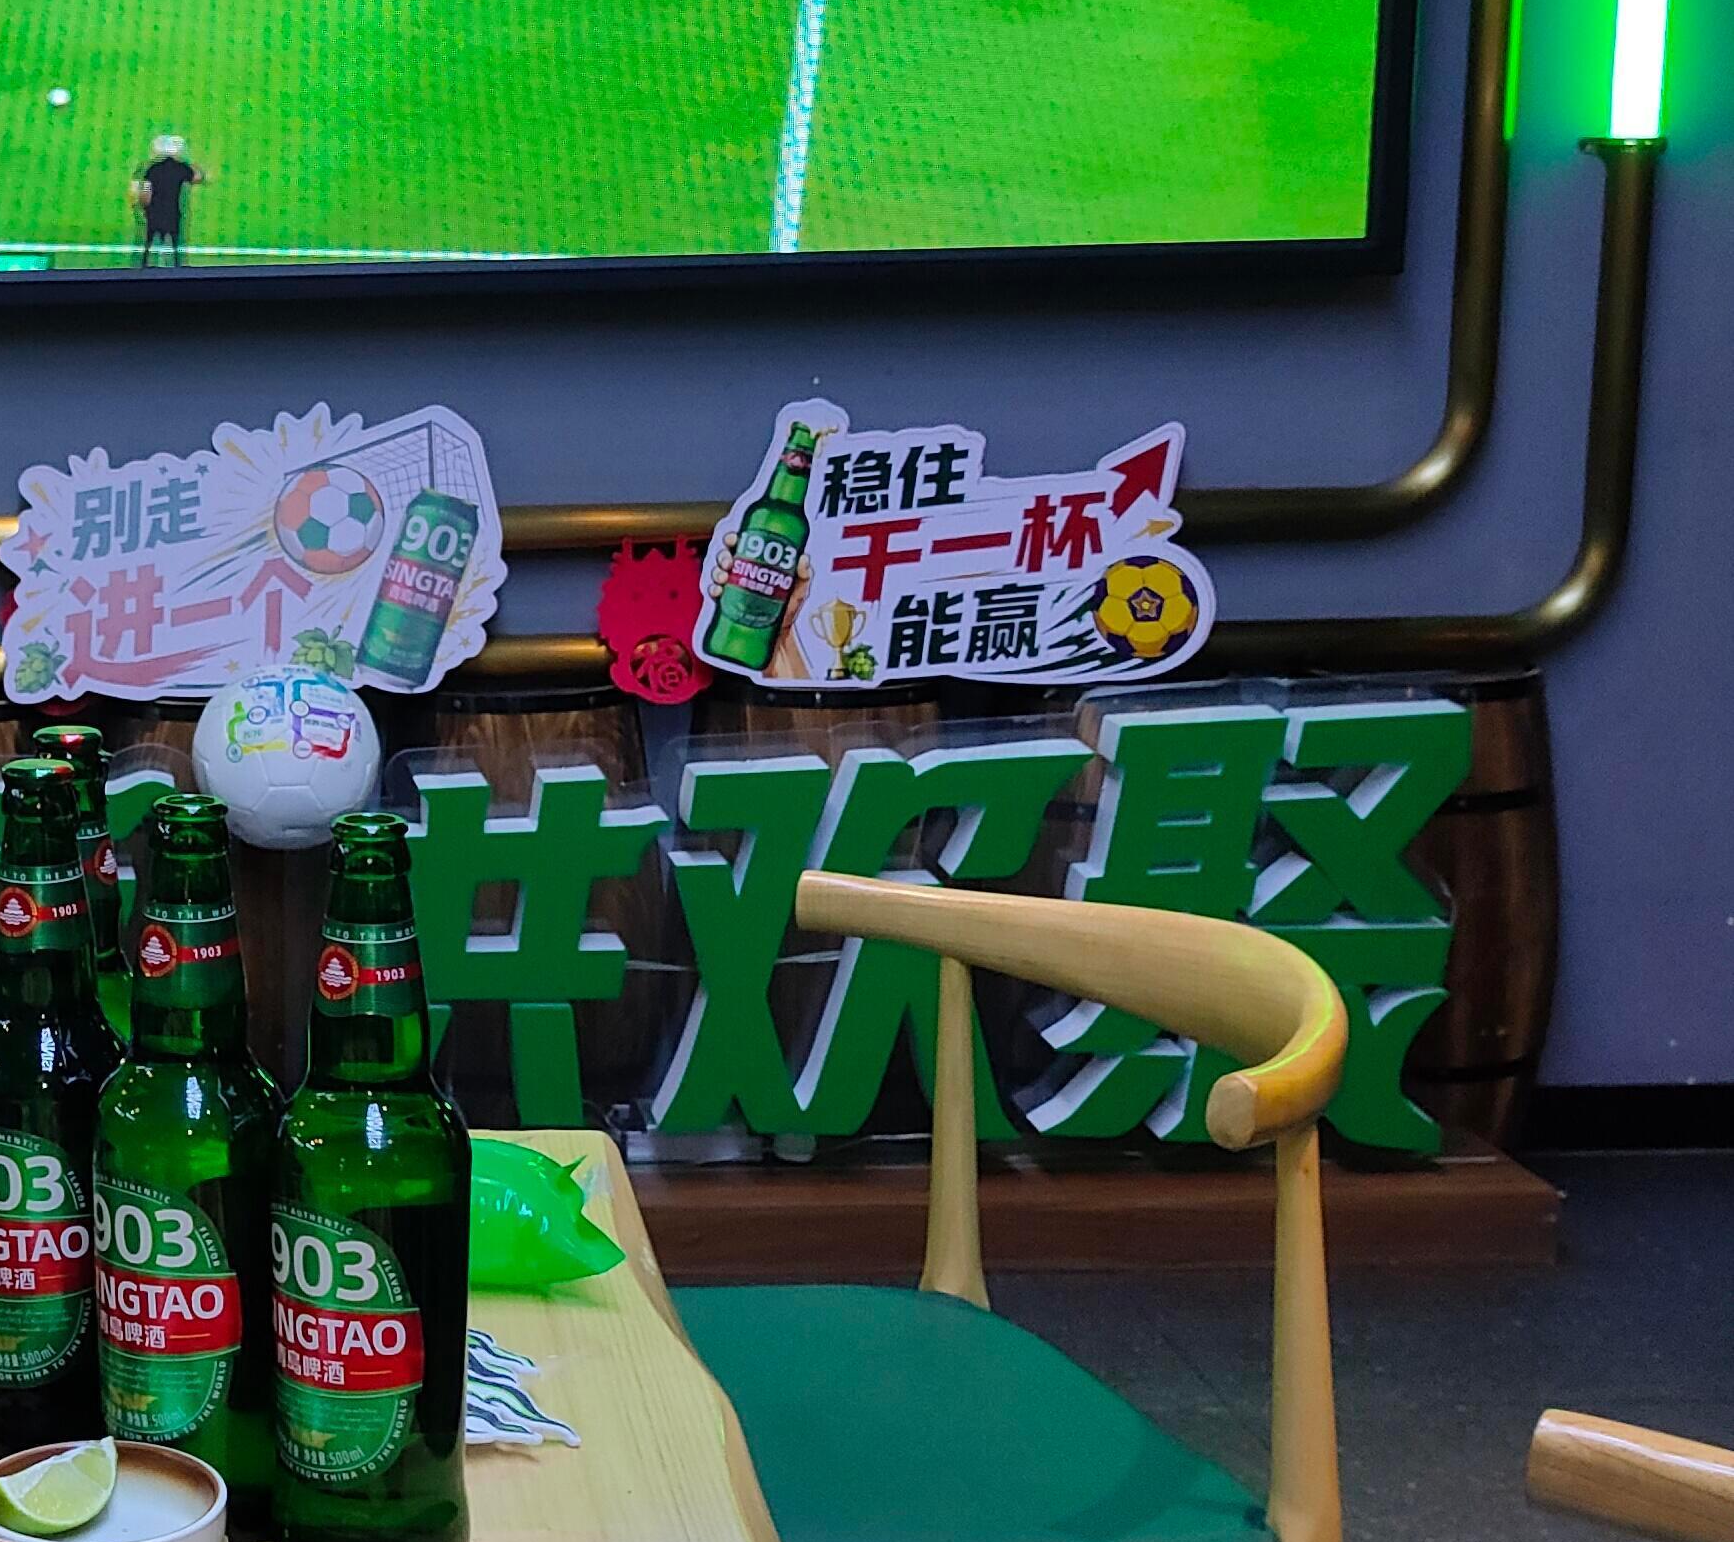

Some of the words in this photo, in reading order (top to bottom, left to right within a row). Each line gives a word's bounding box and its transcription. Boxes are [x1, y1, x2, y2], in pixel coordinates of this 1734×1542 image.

[816, 441, 970, 518] 稳住
[70, 476, 208, 562] 别走
[400, 514, 474, 569] 903
[832, 492, 1107, 603] 干一杯
[736, 531, 798, 571] 1903
[59, 555, 314, 688] 进一个
[886, 583, 1047, 669] 能赢
[51, 903, 78, 918] 1903
[192, 945, 222, 960] 1903
[375, 967, 405, 982] 1903
[94, 1192, 198, 1269] 903
[198, 1225, 221, 1268] FLAVOR
[270, 1222, 380, 1302] 903
[381, 1258, 404, 1303] FLAVOR
[95, 1265, 225, 1321] INGTAO
[273, 1298, 407, 1357] INGTAO
